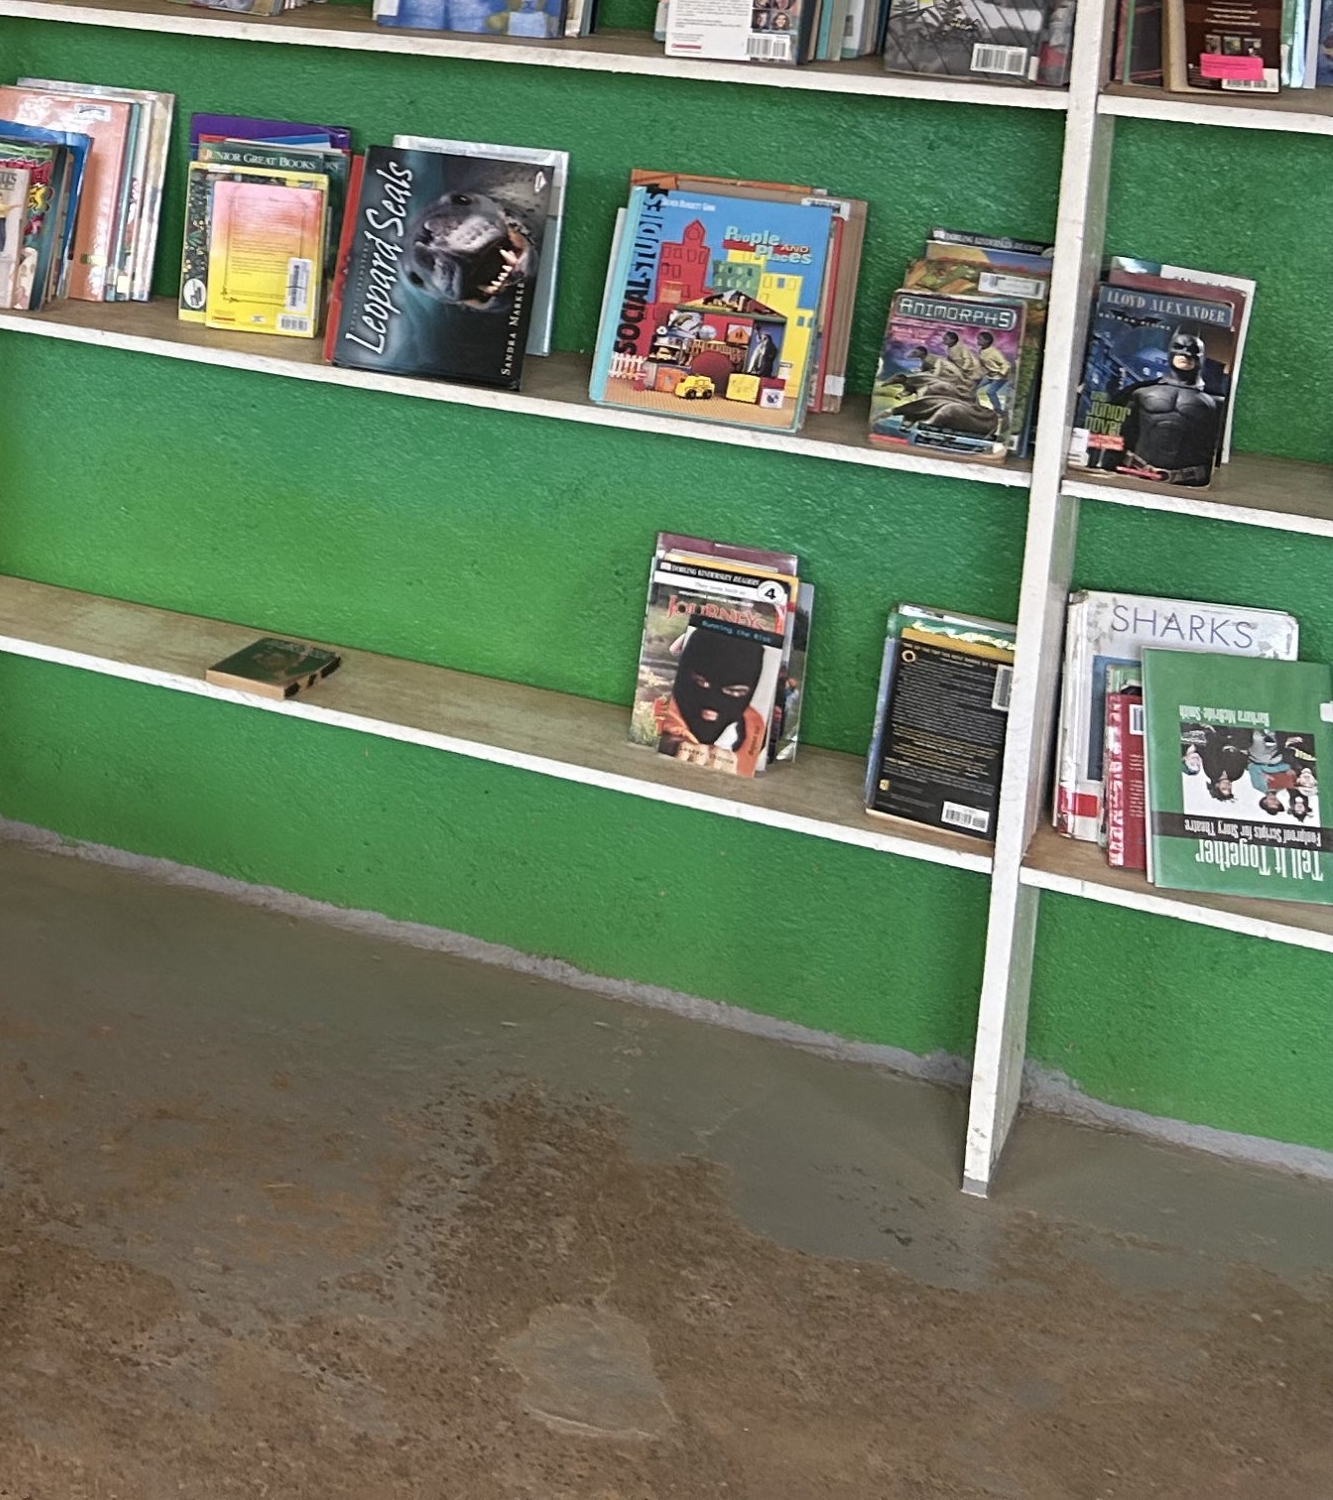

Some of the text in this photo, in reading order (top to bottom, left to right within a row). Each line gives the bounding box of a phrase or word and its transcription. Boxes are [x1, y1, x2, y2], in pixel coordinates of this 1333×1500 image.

[204, 150, 316, 170] JUNIOR GREAT BOOKS
[725, 225, 810, 253] People AND
[344, 160, 414, 355] Leopard Seals
[614, 184, 669, 354] SOCIAL STUDIES
[755, 244, 814, 265] Places
[898, 300, 1012, 327] ANIMORPHS
[1107, 289, 1226, 324] LLOYD ALEXANDER
[501, 282, 525, 376] SANDRA MARKLE
[697, 568, 732, 583] KINDERSLEY
[732, 573, 760, 586] READERS
[764, 586, 778, 601] 4
[667, 594, 766, 632] JOURNEYS
[1111, 604, 1253, 649] SHARKS
[701, 619, 772, 644] Running the Risk
[1237, 712, 1270, 727] Barbara
[1184, 817, 1322, 847] Foolproof Scripts for Story Theatre
[1195, 837, 1324, 882] Tell It Together
